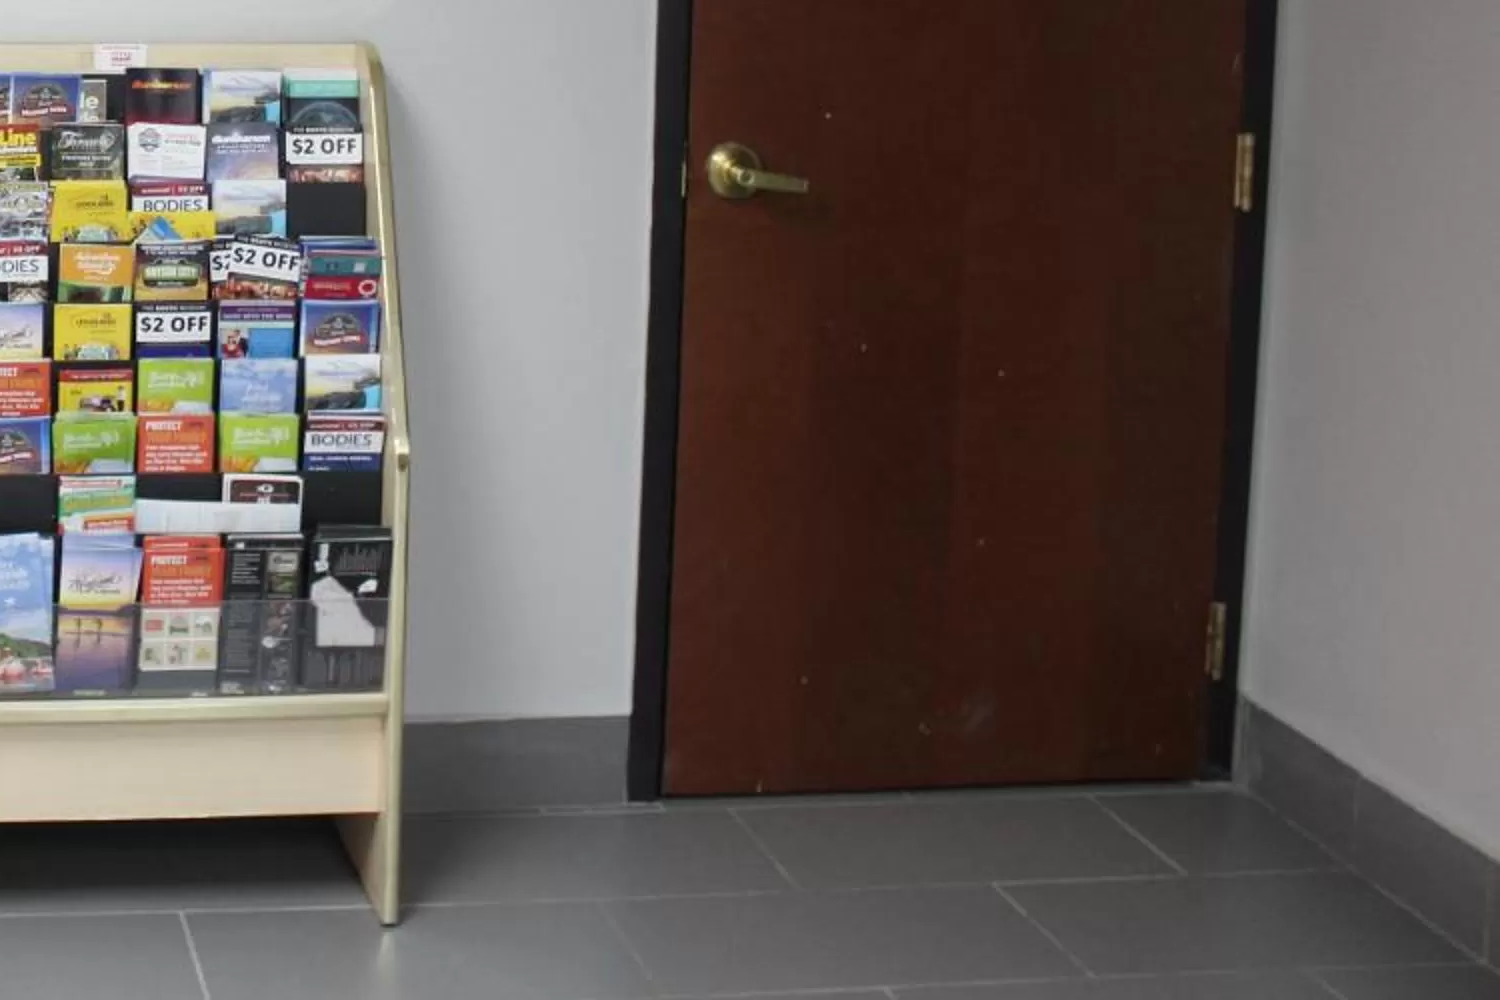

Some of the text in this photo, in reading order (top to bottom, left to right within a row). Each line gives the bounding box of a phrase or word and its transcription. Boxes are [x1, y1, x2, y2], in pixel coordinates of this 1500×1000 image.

[292, 138, 356, 155] $2 OFF
[143, 199, 203, 212] BODIES
[233, 247, 299, 271] $2 OFF
[141, 315, 208, 333] $2 OFF
[311, 433, 372, 447] BODIES
